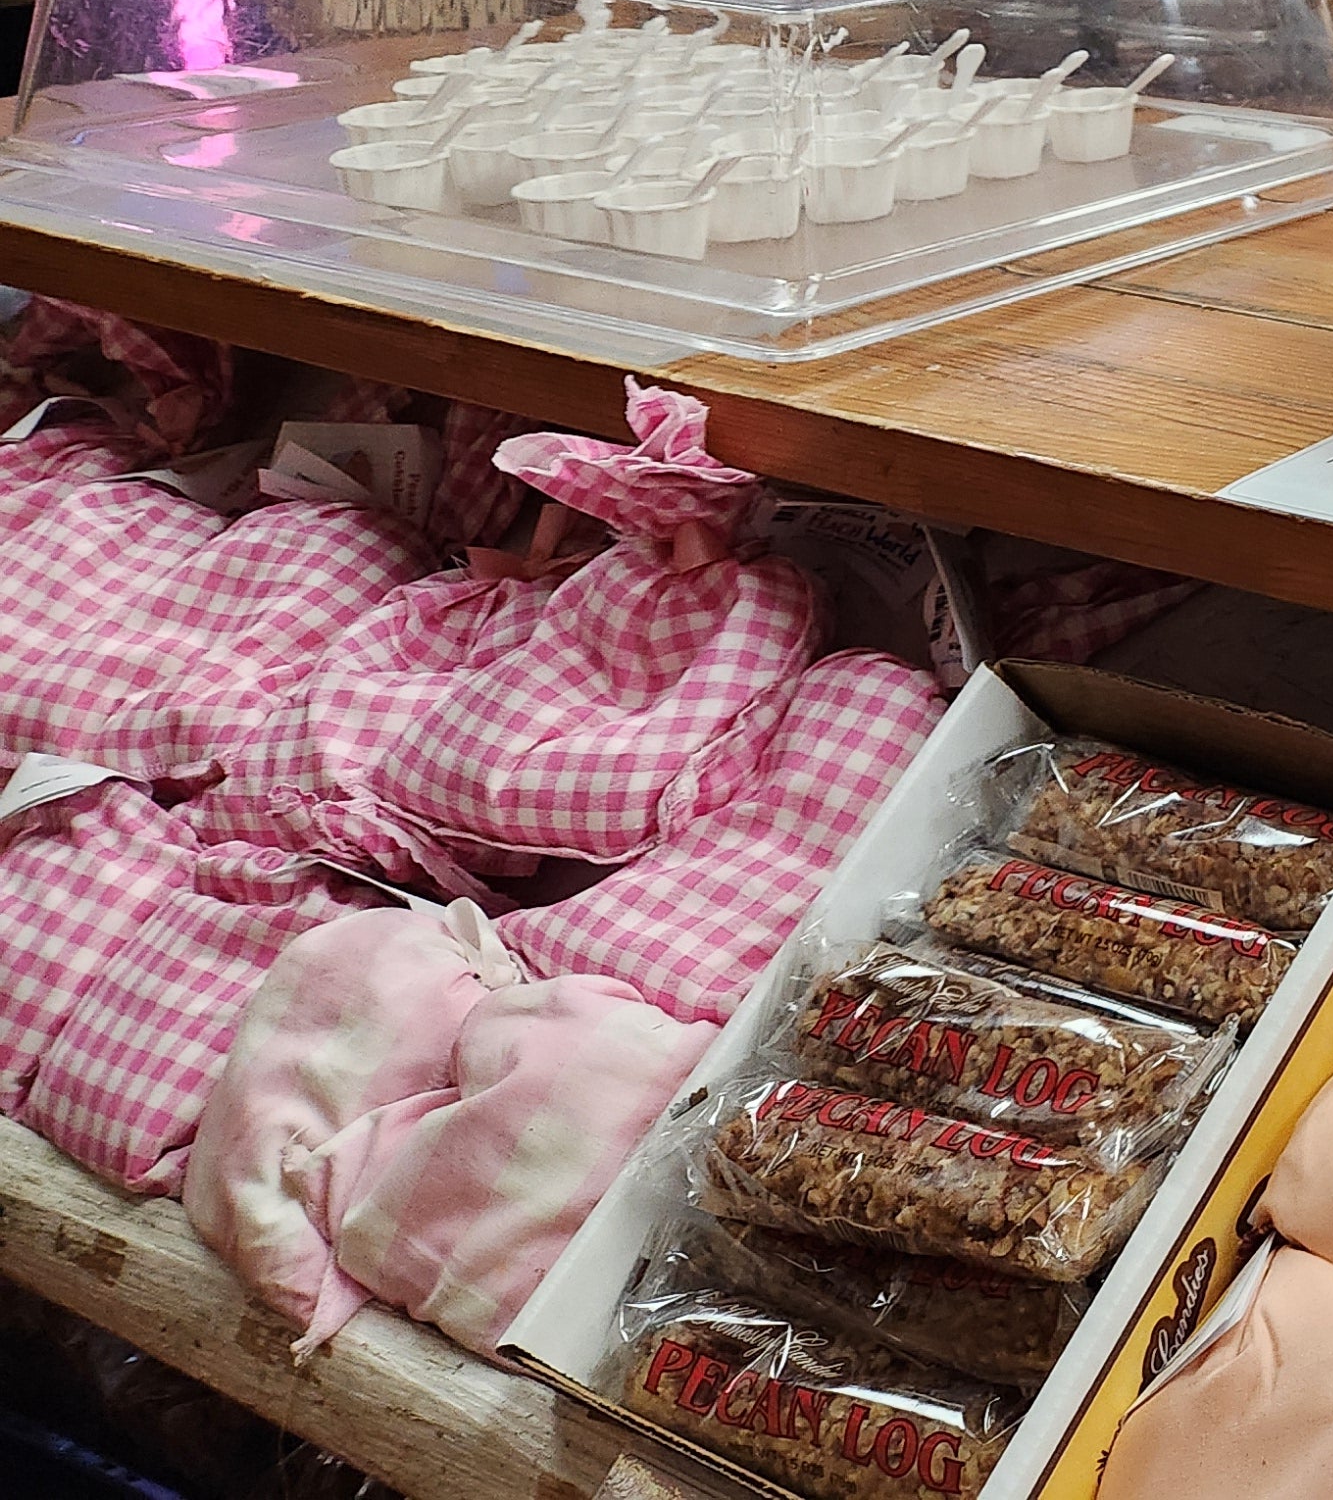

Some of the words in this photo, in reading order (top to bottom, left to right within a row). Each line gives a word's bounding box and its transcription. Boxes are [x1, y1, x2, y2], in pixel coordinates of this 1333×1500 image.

[866, 525, 922, 566] World
[1071, 752, 1238, 811] PECAN
[986, 859, 1152, 928] PECAN
[1160, 903, 1273, 959] LOG
[808, 988, 978, 1086] PECAN
[978, 1043, 1101, 1115] LOG
[755, 1080, 930, 1142] PECAN
[930, 1119, 1054, 1171] LOG
[1150, 1249, 1211, 1378] Candies
[643, 1337, 829, 1448] PECAN
[841, 1403, 967, 1495] LOG
